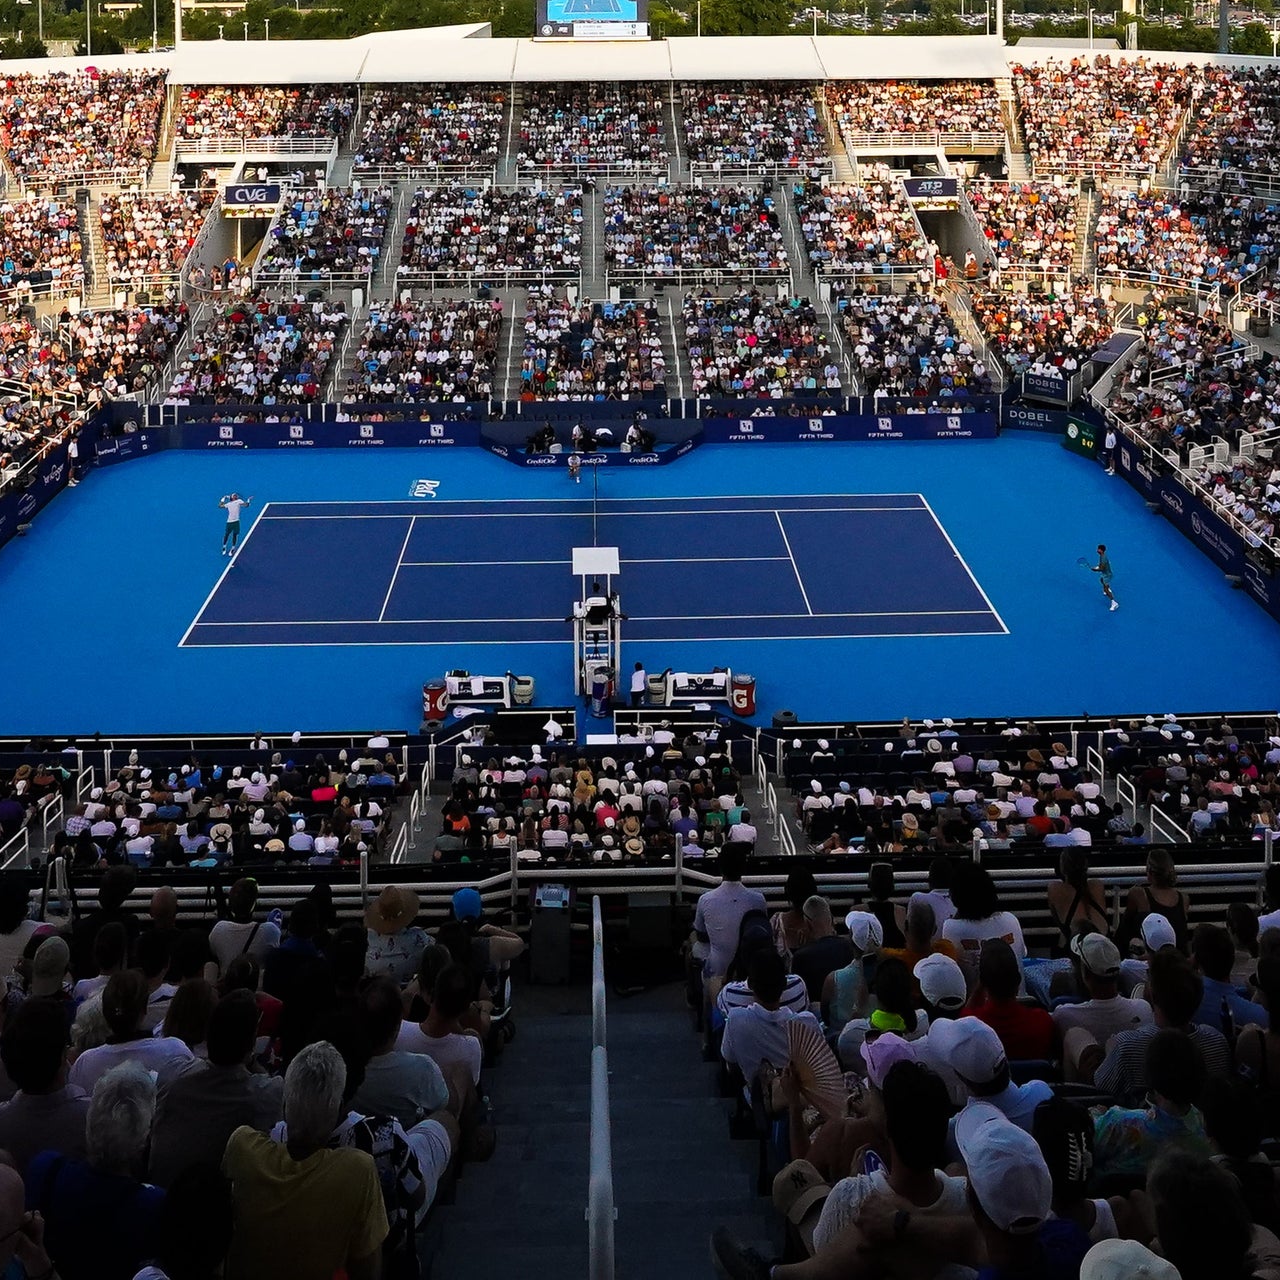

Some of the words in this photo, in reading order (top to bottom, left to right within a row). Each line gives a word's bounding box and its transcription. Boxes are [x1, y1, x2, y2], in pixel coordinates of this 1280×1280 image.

[918, 181, 943, 190] ATP
[235, 188, 268, 202] CVG
[1028, 377, 1062, 390] DOBEL
[1009, 410, 1052, 422] DOBEL
[526, 456, 557, 465] CreditOne
[629, 455, 660, 464] CreditOne
[733, 689, 748, 708] G
